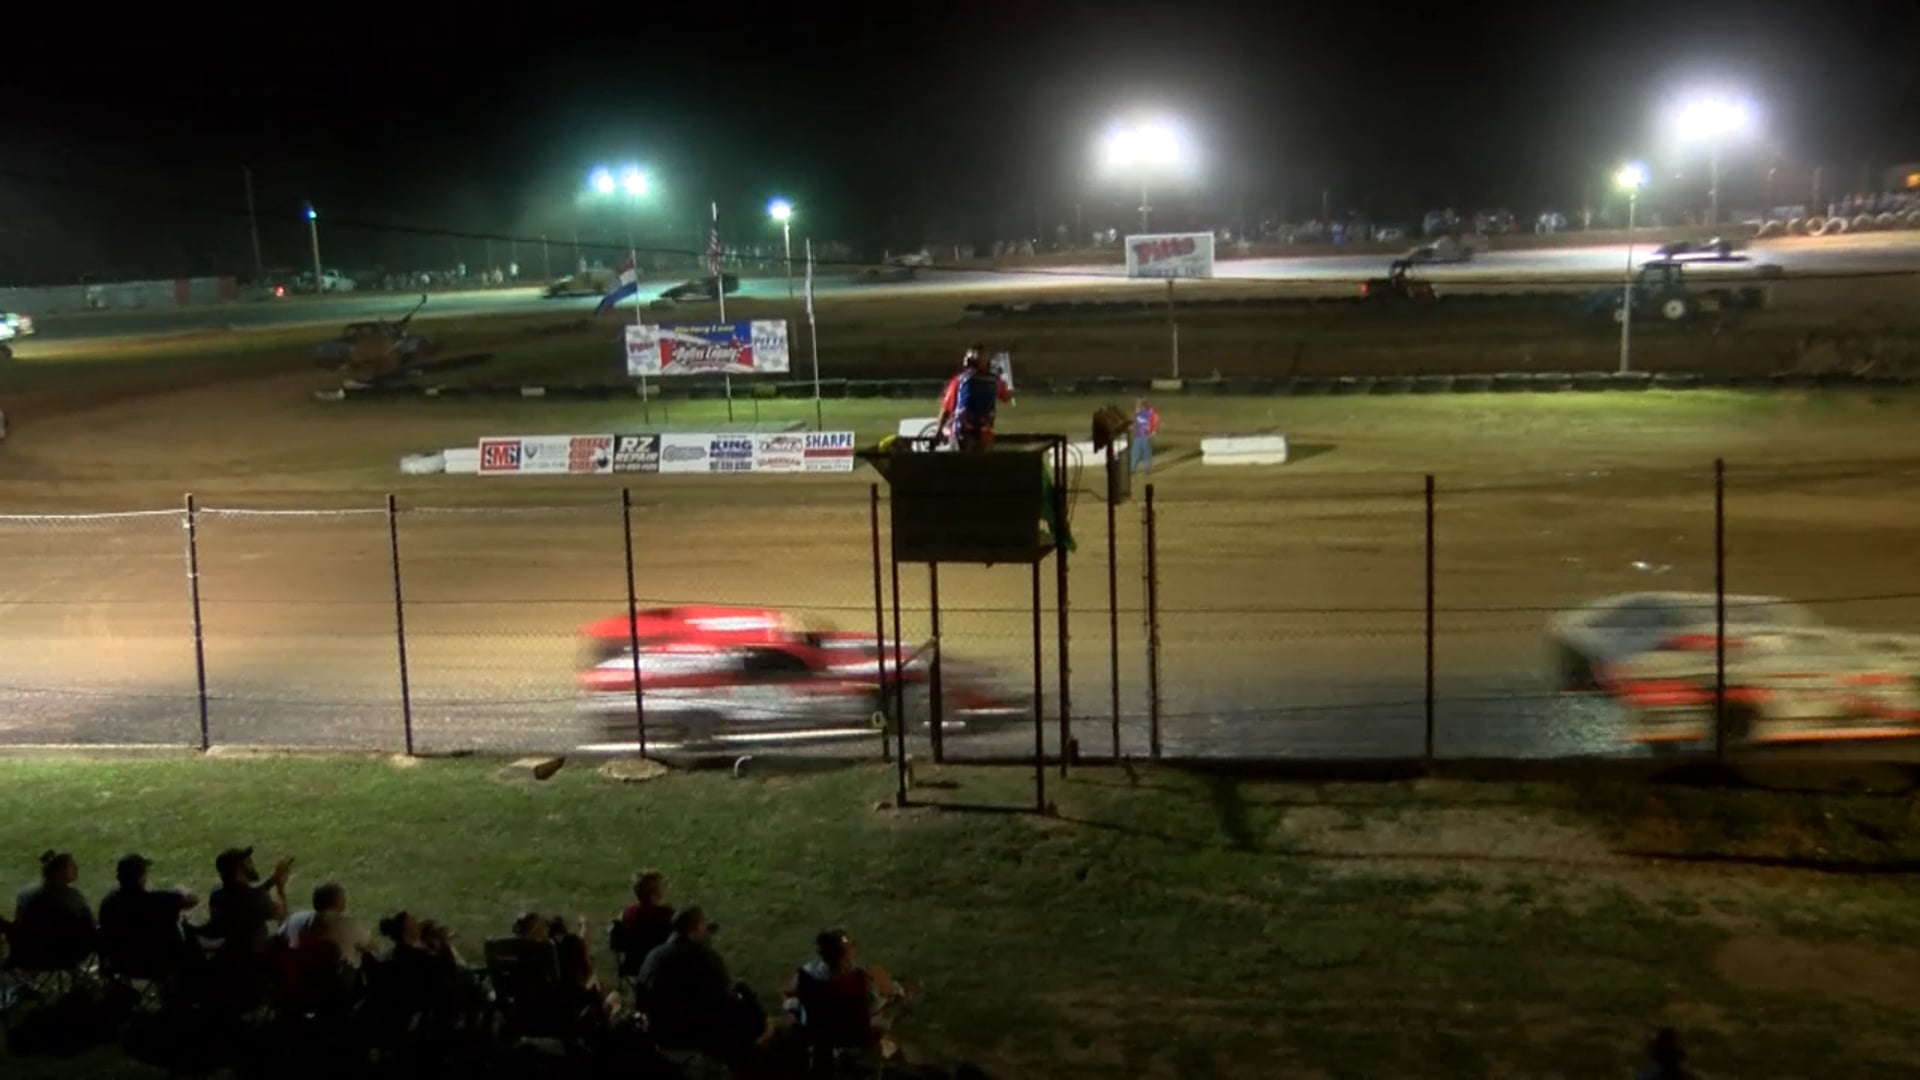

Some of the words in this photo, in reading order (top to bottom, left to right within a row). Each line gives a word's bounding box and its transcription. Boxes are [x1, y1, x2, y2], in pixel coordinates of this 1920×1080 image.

[619, 436, 654, 452] RZ
[710, 440, 753, 451] KING
[806, 435, 853, 448] SHARPE
[614, 452, 659, 463] REPAIR
